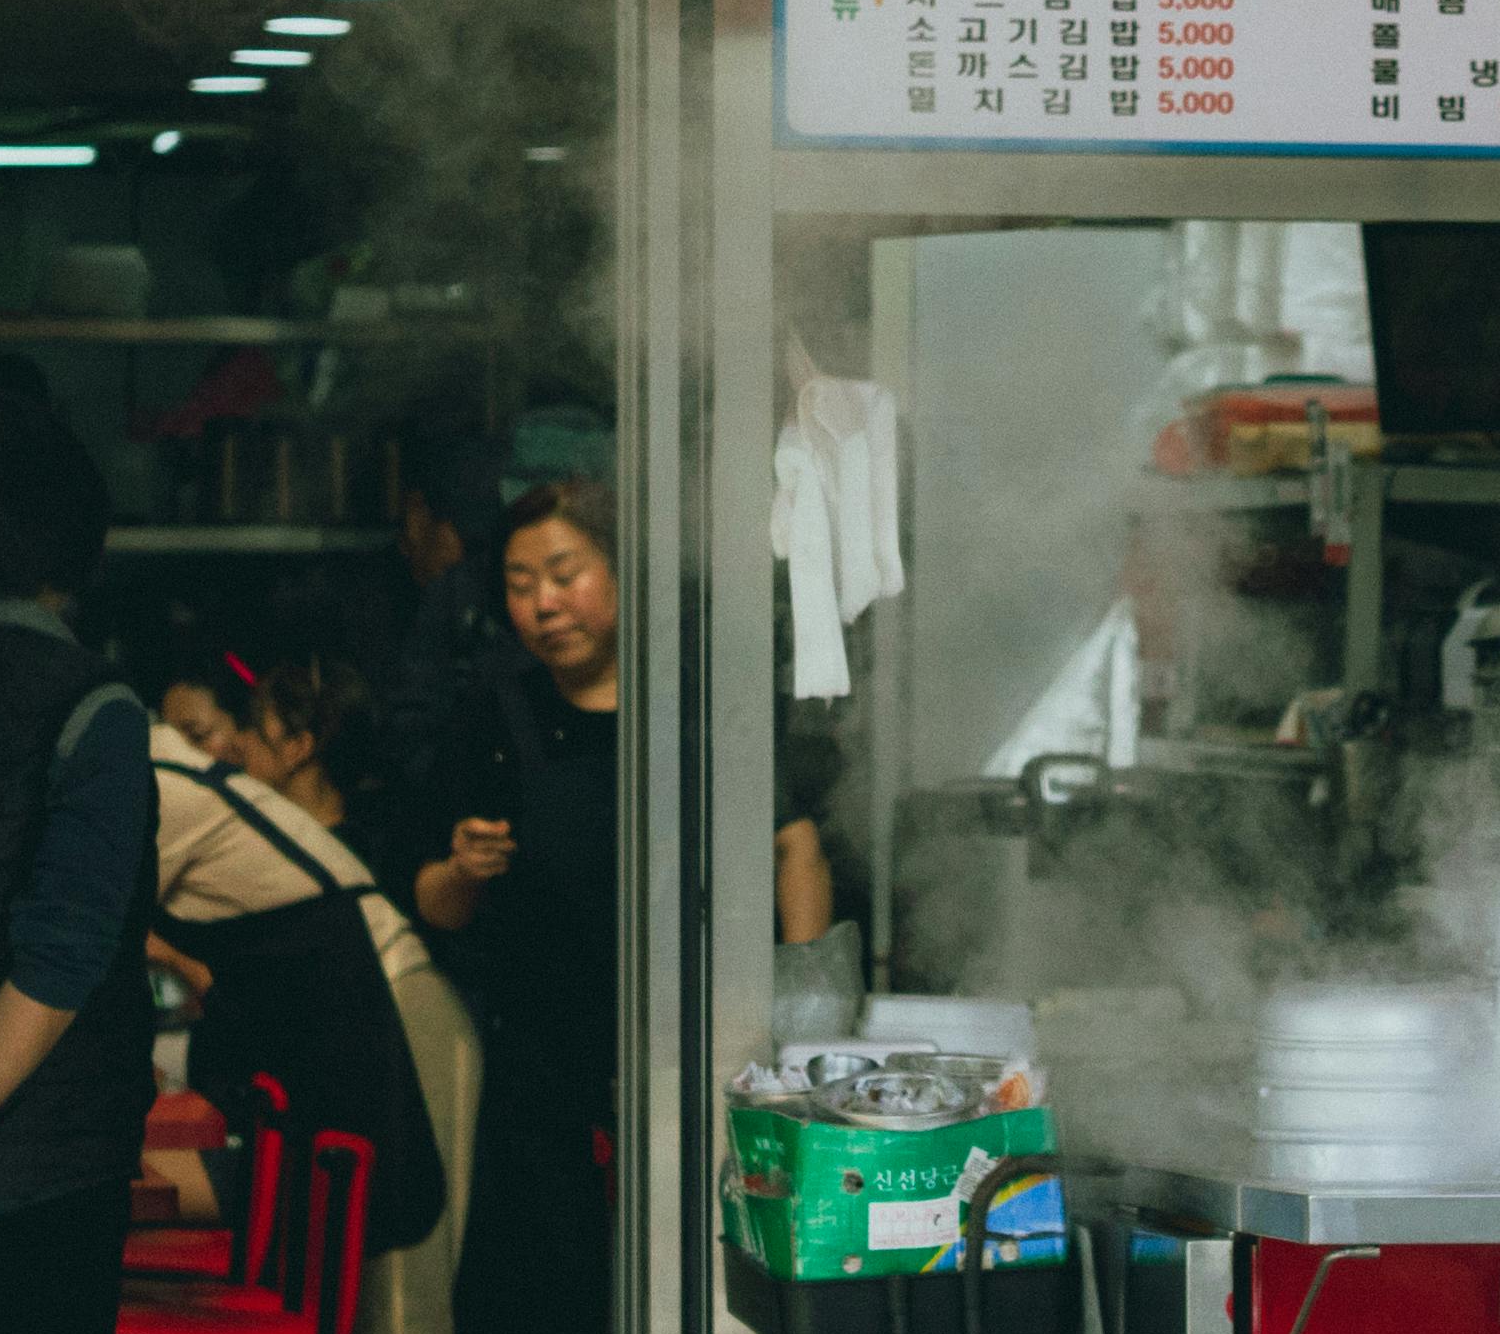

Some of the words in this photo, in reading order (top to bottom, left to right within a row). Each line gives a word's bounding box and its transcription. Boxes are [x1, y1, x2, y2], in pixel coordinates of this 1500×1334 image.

[908, 16, 1139, 47] 소고기김밥
[1158, 21, 1234, 46] 5,000
[908, 51, 1140, 81] 돈까스김밥
[1158, 56, 1234, 80] 5,000
[1158, 91, 1234, 114] 5,000
